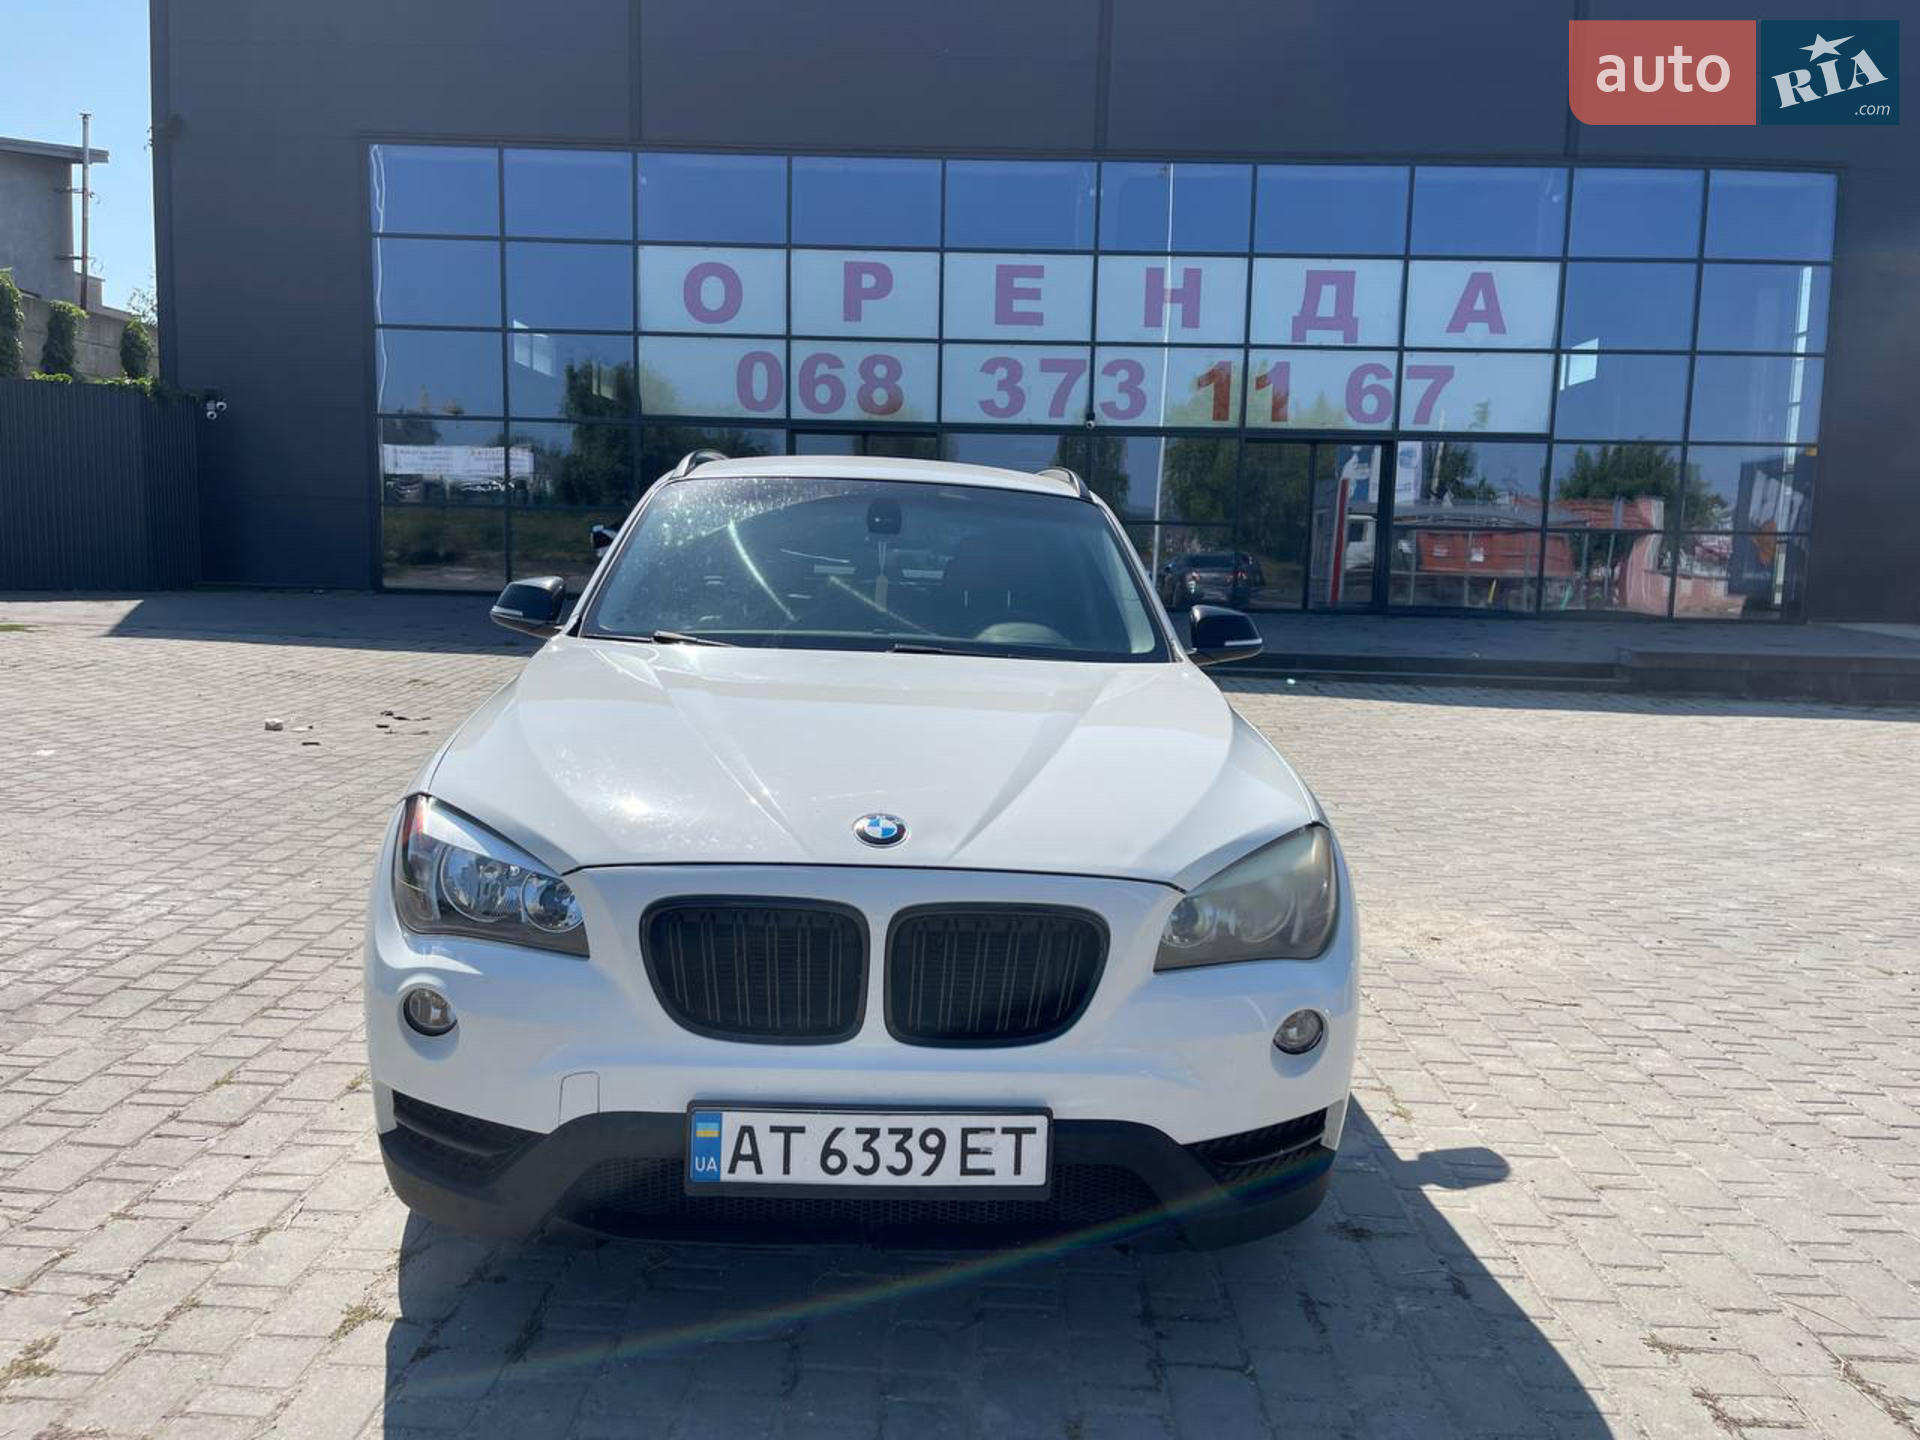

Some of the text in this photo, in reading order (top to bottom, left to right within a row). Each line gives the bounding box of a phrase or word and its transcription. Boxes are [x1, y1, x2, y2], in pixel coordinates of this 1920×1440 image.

[683, 260, 1507, 344] ОРЕНДА
[736, 350, 1455, 425] 068 373 11 67
[695, 1156, 718, 1172] UA
[727, 1125, 1037, 1177] AT 6339 ET
